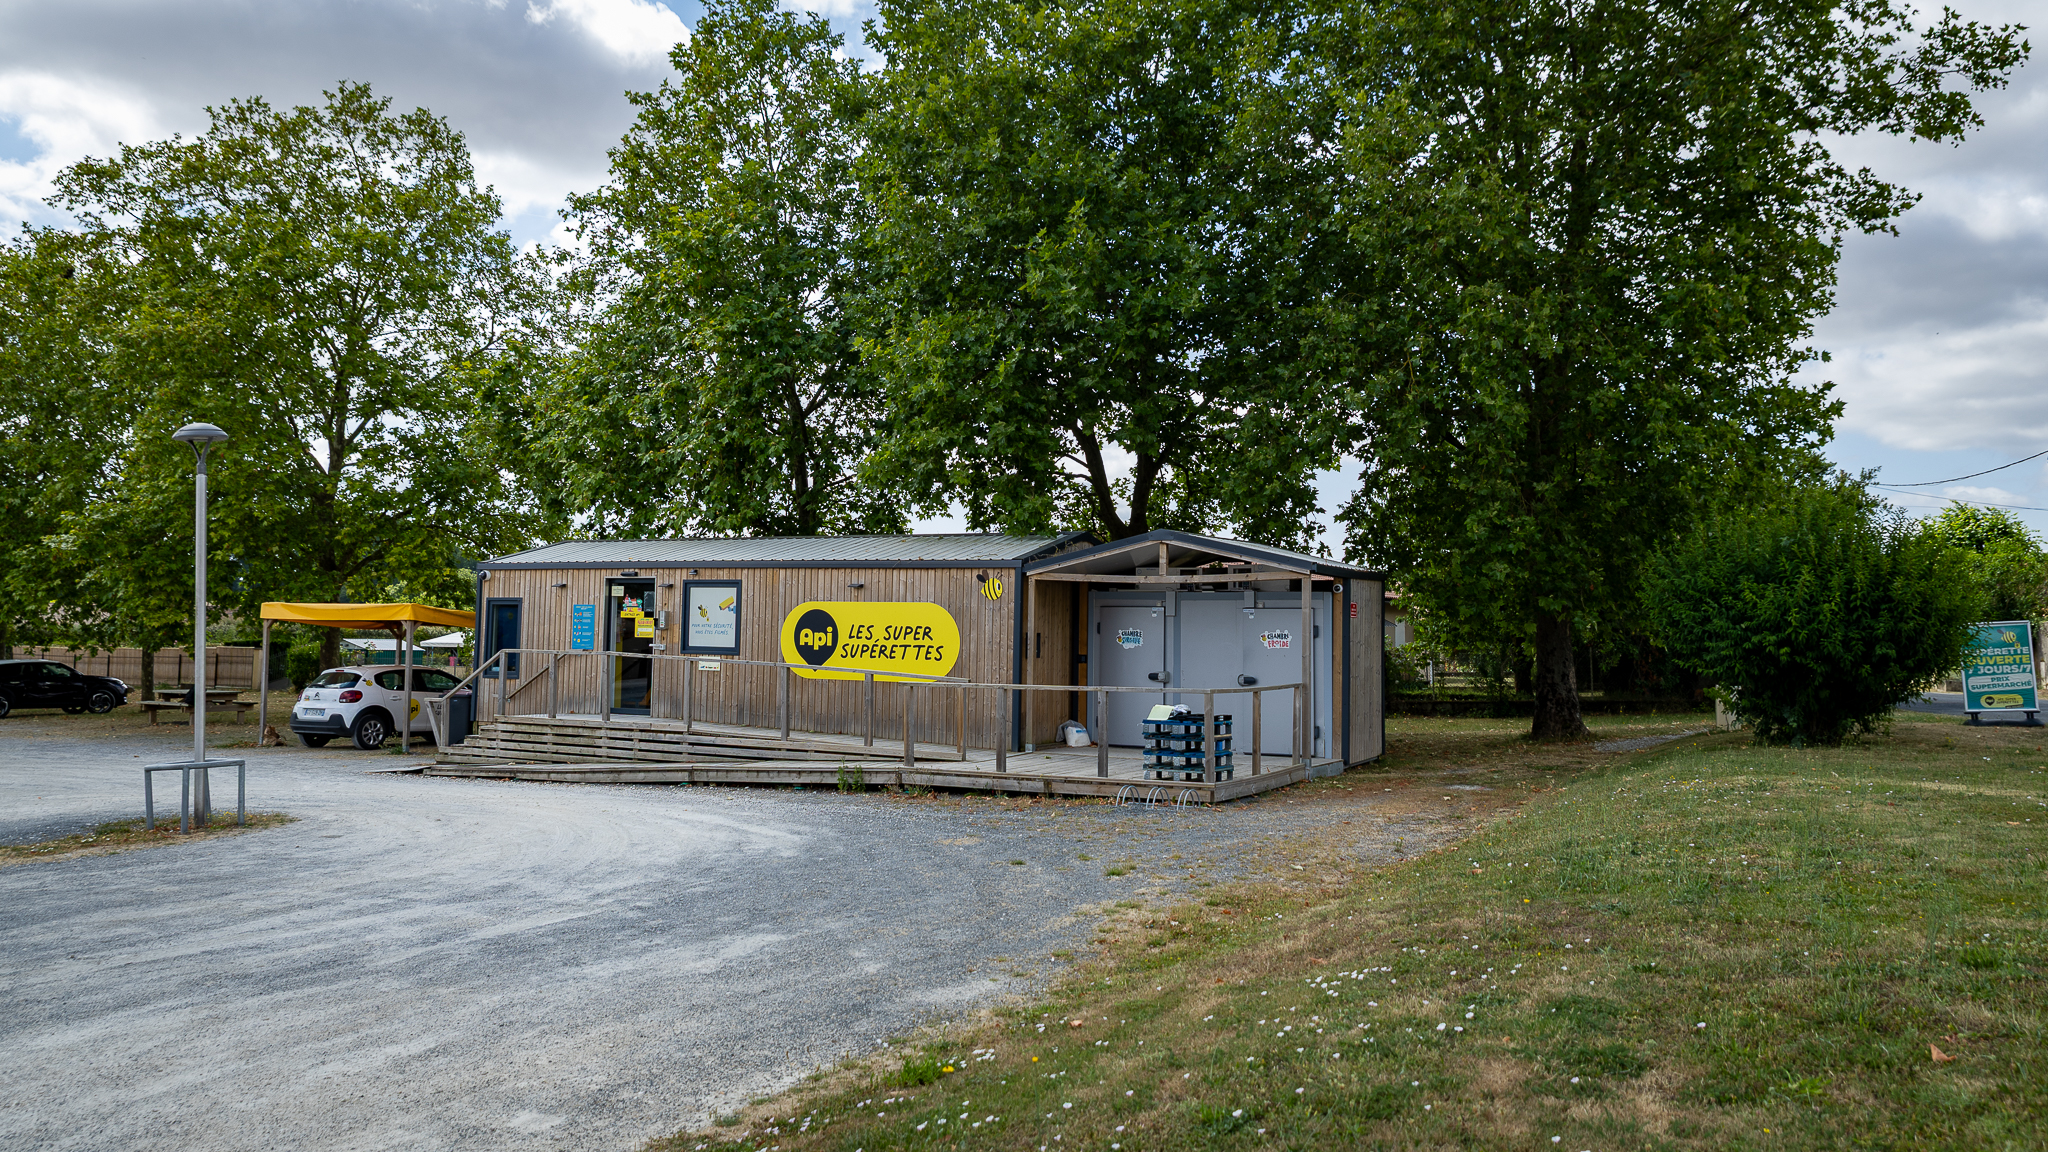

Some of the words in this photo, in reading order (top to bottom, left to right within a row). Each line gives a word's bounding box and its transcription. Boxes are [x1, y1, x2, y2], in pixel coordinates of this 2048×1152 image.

[799, 626, 833, 650] Api
[848, 624, 874, 640] LES
[883, 625, 933, 641] SUPER
[840, 638, 944, 661] SUPÉRETTES
[1267, 639, 1289, 648] FROIDE
[1977, 664, 2031, 674] JOURS/7
[1971, 679, 2032, 689] SUPERMARCHÉ
